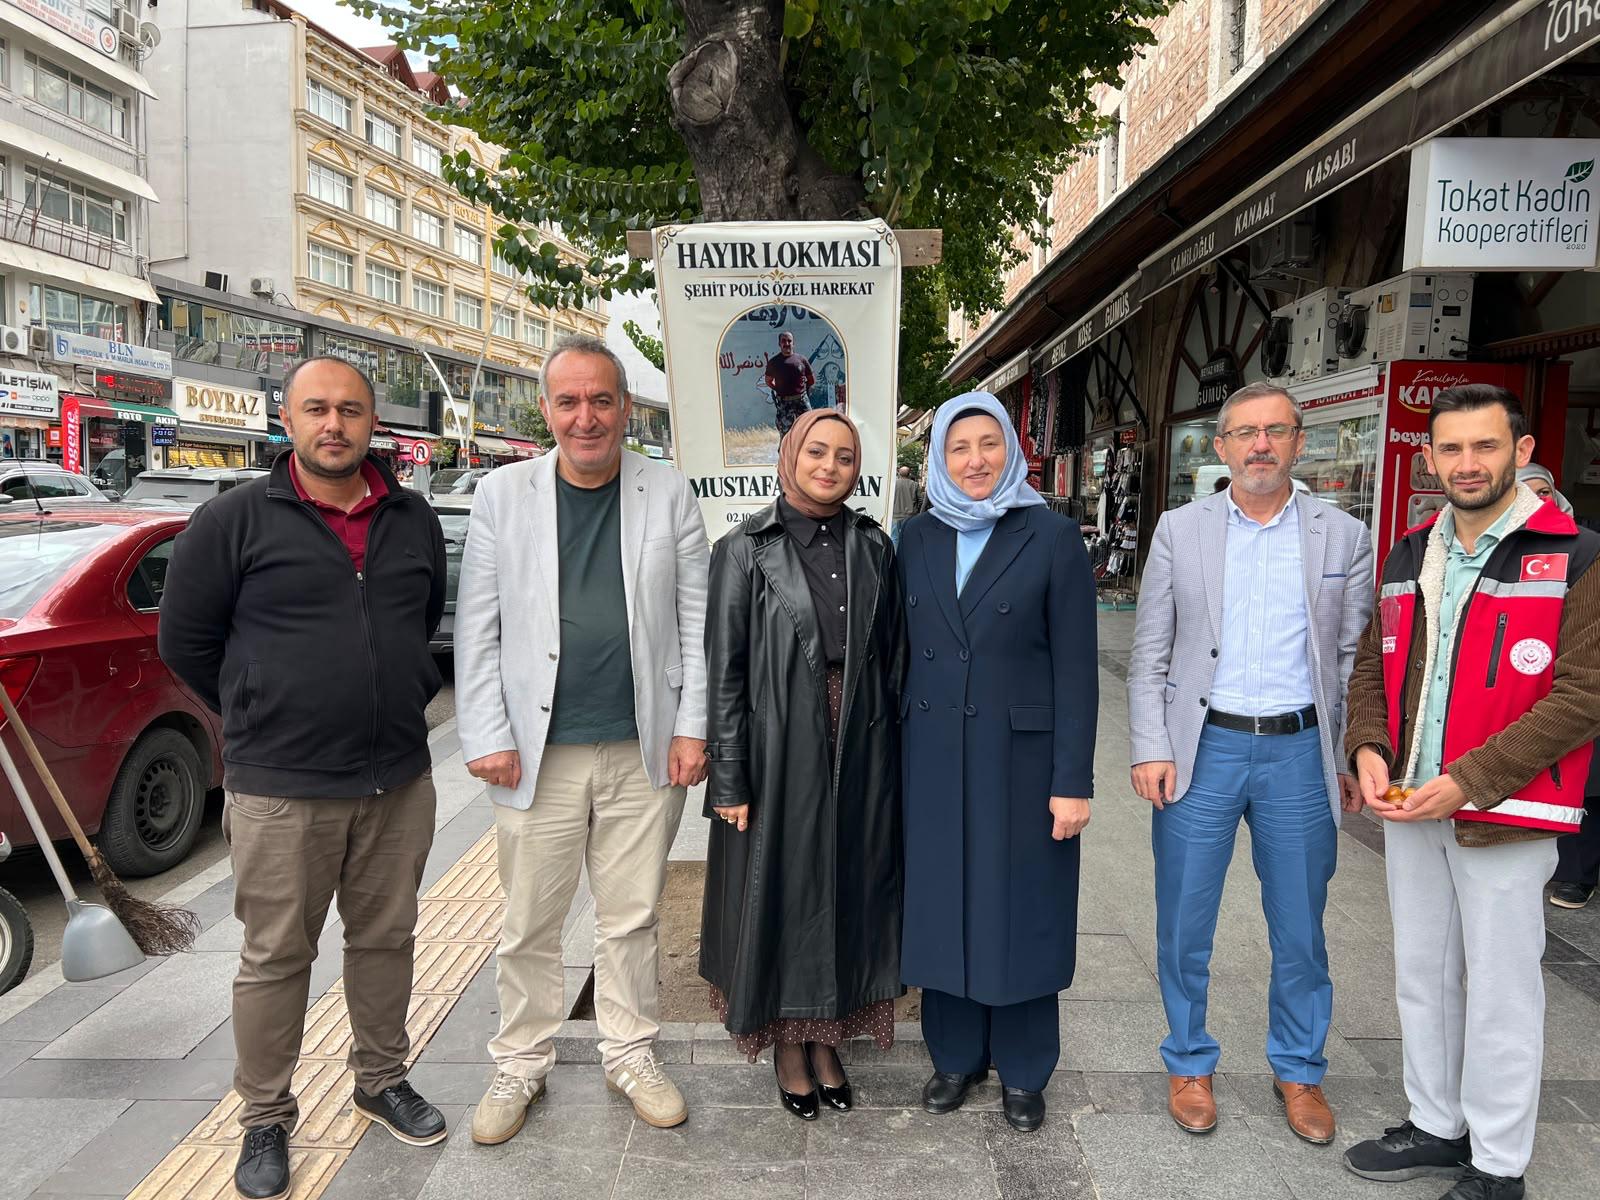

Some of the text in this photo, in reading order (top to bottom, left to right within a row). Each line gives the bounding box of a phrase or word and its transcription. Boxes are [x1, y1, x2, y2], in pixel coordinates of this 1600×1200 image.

[1234, 191, 1277, 237] KANAAT
[1304, 137, 1358, 193] KASABI
[1437, 179, 1591, 213] Tokat Kadın
[1438, 216, 1589, 250] Kooperatifleri
[677, 239, 881, 269] HAYIR LOKMASI
[684, 280, 875, 300] ŞEHİT POLİS ÖZEL HAREKAT
[108, 341, 134, 357] BLN
[186, 385, 260, 416] BOYRAZ
[117, 411, 142, 421] FOTO
[1389, 427, 1431, 447] beyp
[726, 512, 751, 523] 02.10
